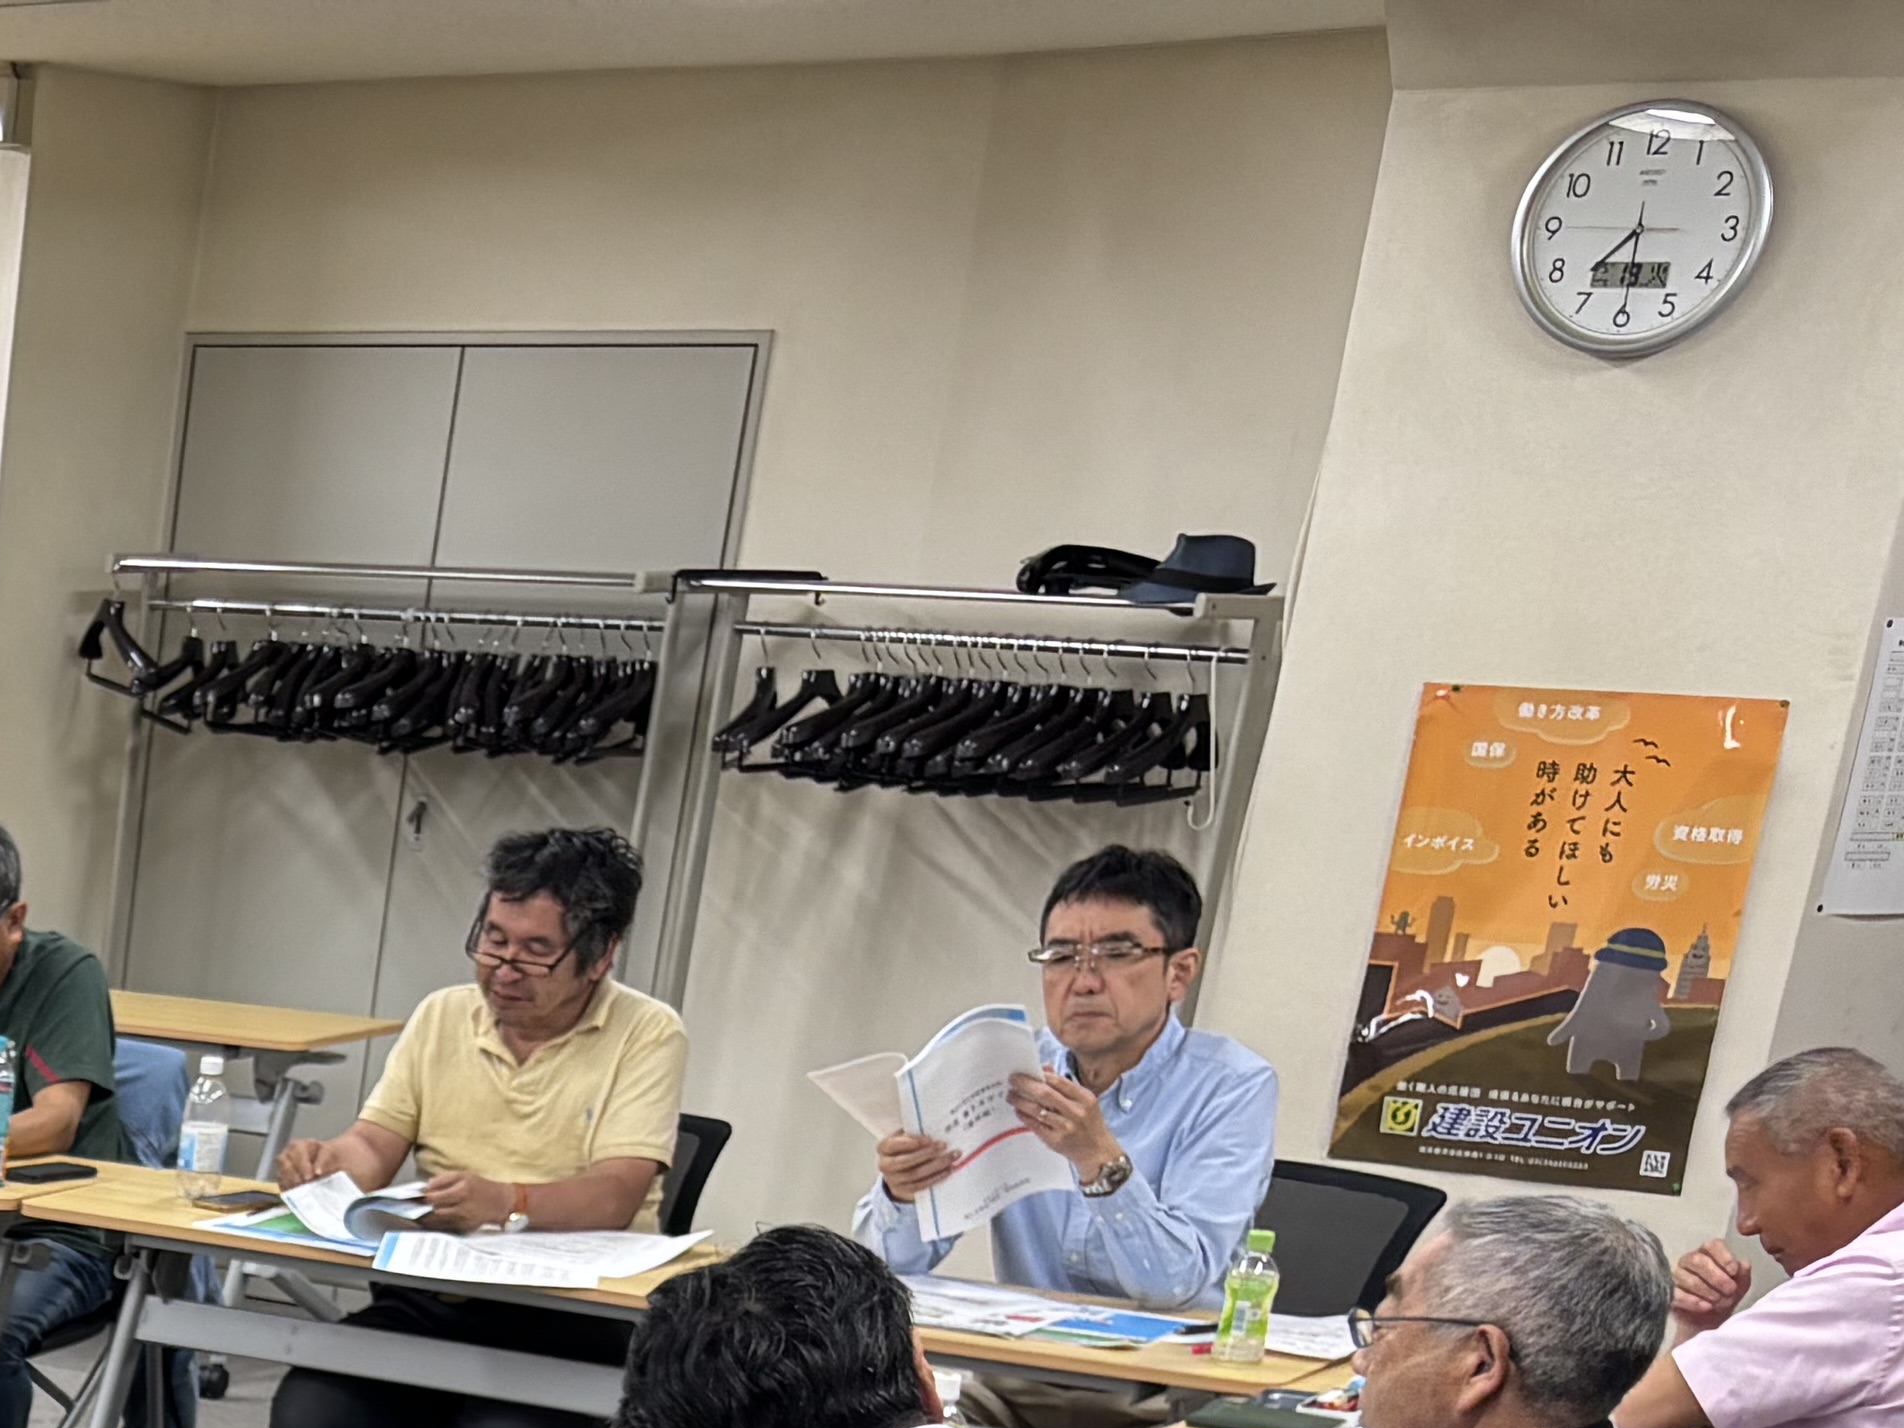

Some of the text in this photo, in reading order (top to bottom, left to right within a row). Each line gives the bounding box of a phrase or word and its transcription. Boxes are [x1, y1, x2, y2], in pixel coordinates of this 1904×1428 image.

[1606, 140, 1624, 166] 11
[1646, 129, 1672, 156] 12
[1694, 140, 1704, 165] 1
[1566, 173, 1591, 199] 10
[1713, 170, 1734, 197] 2
[1544, 216, 1563, 240] 9
[1720, 215, 1739, 242] 3
[1549, 258, 1565, 283] 8
[1695, 258, 1714, 284] 4
[1576, 292, 1593, 314] 7
[1658, 293, 1677, 317] 5
[1613, 306, 1631, 328] 6
[1518, 702, 1602, 721] 働き方改革
[1523, 760, 1560, 859] 時がある
[1599, 763, 1636, 863] 大人にも
[1402, 834, 1476, 852] インボイス
[1547, 762, 1598, 910] 助けてほしい
[1673, 825, 1745, 847] 資格取得
[1644, 874, 1679, 893] 労災
[1422, 1103, 1646, 1155] 建設ユニオン
